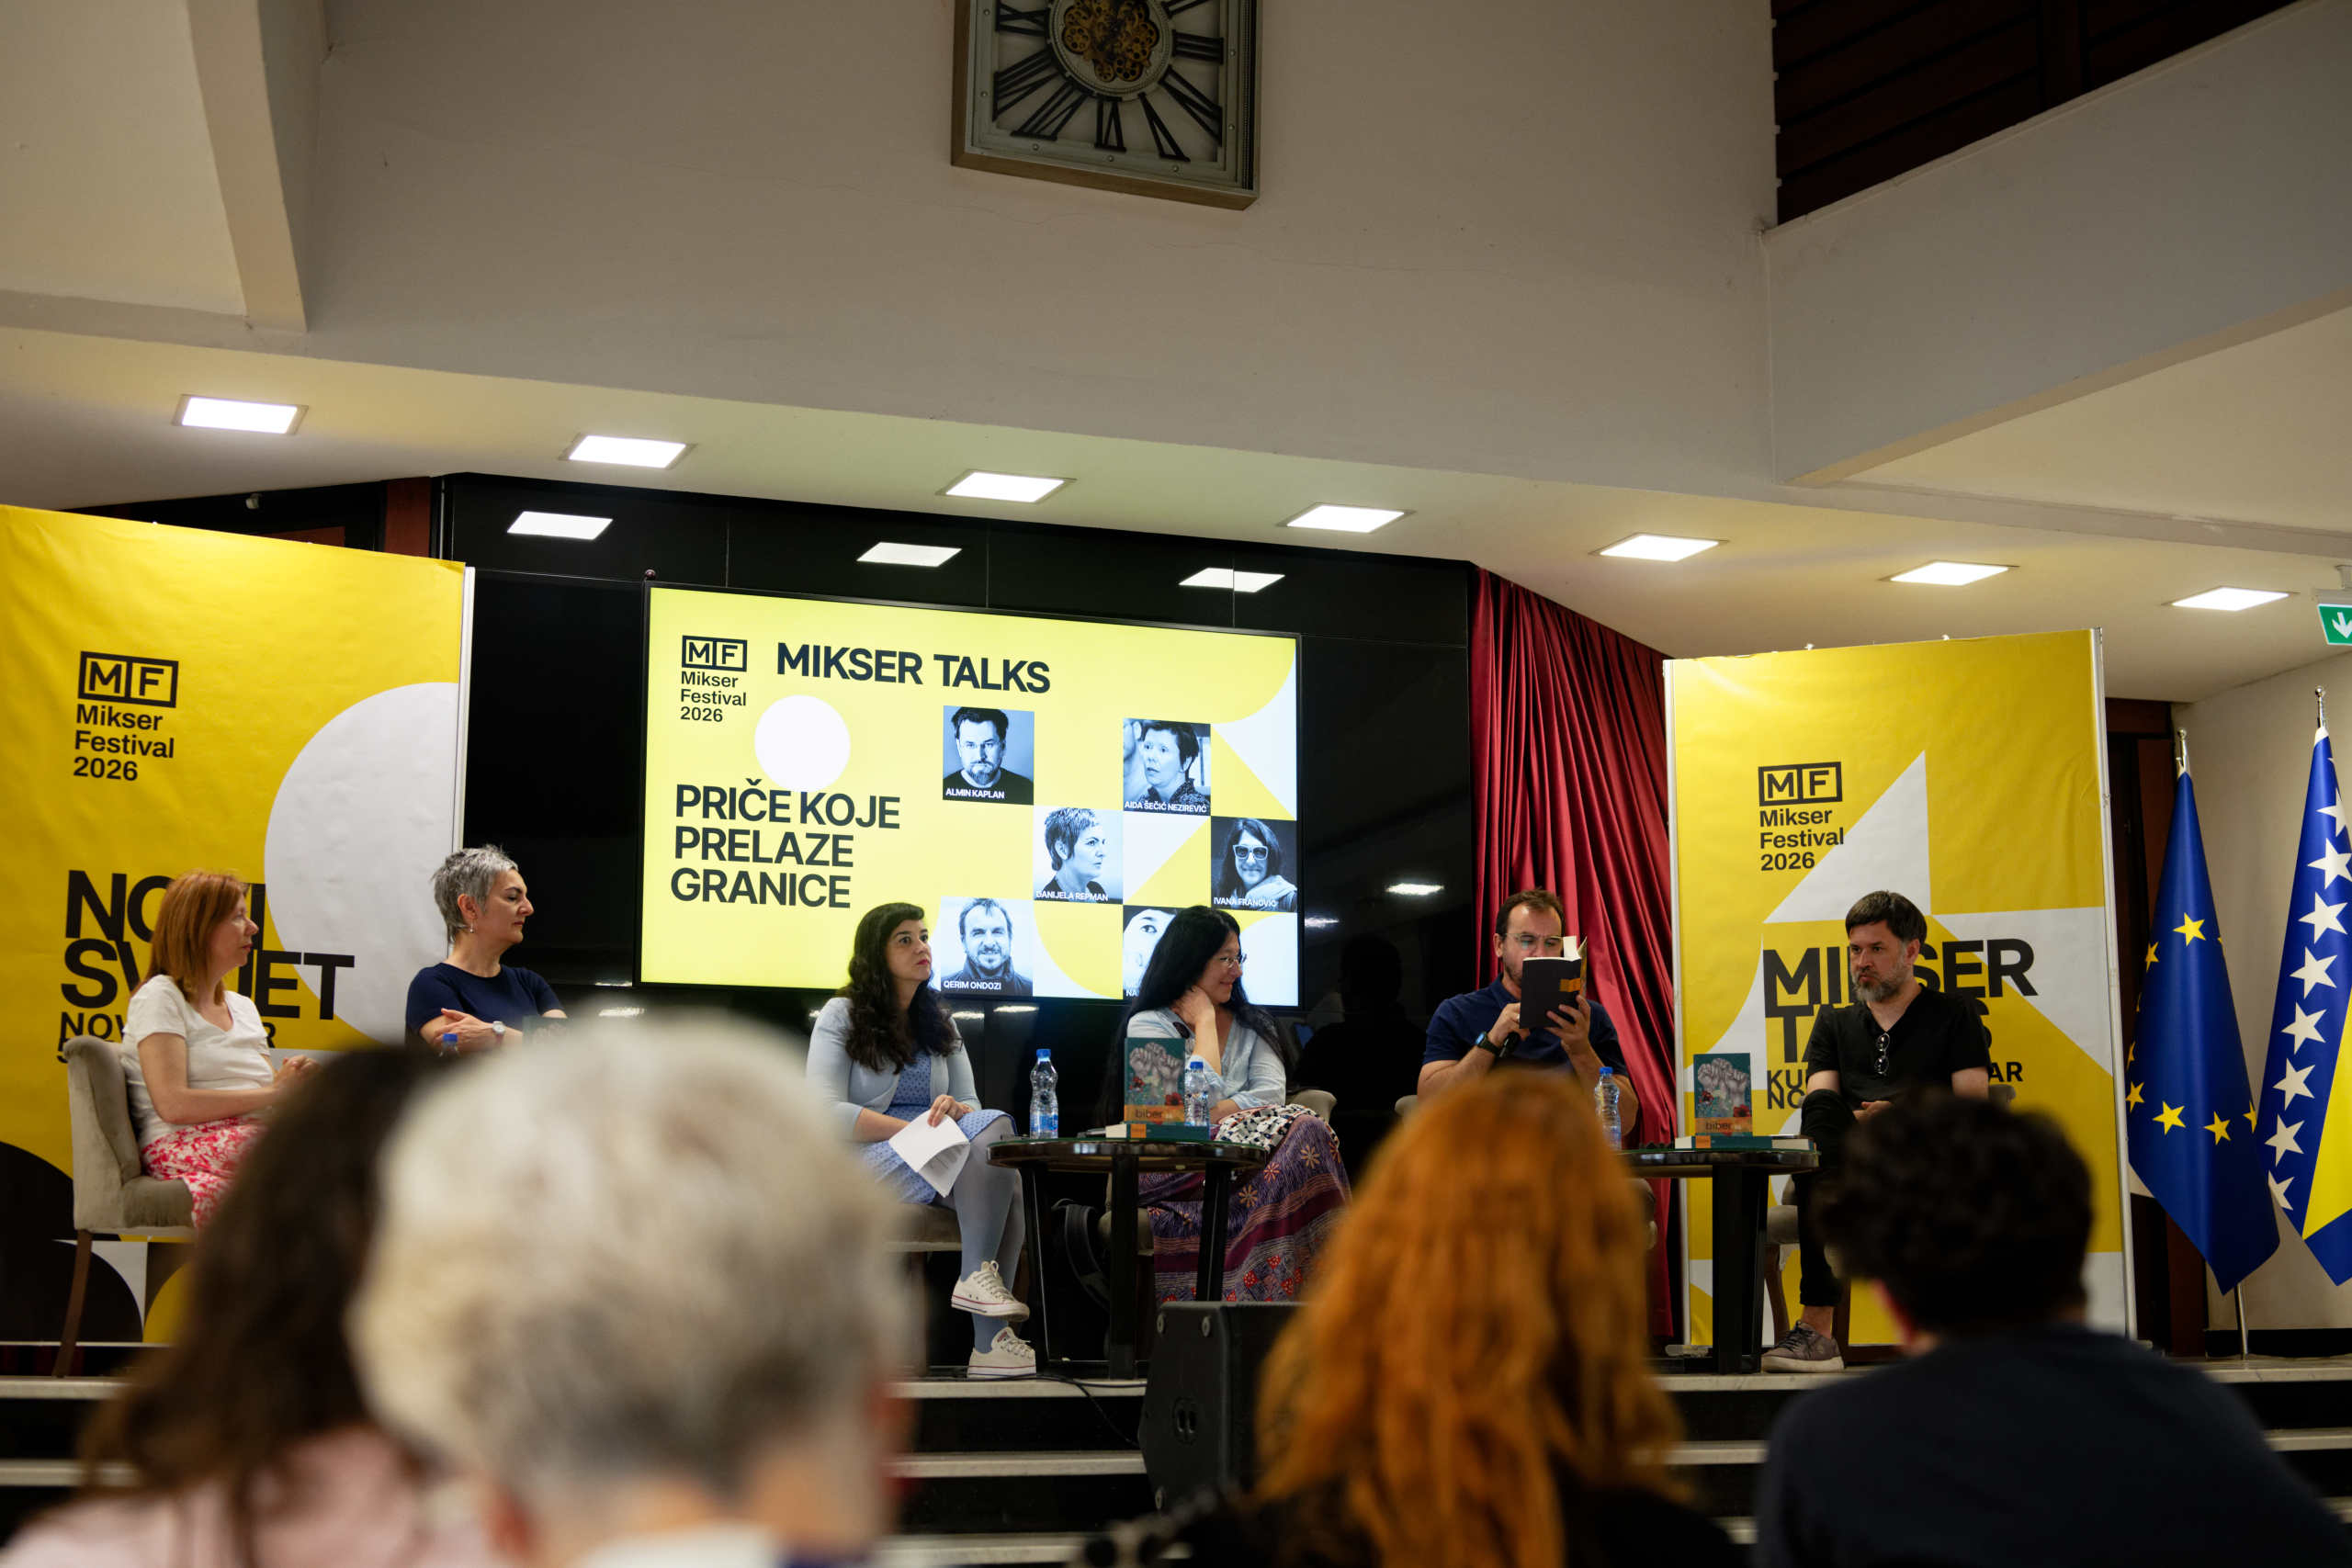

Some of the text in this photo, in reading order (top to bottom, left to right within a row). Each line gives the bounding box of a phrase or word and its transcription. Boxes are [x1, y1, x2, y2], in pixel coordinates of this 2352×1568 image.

[777, 642, 923, 685] MIKSER
[933, 653, 1051, 694] TALKS
[681, 671, 739, 688] Mikser
[680, 688, 747, 706] Festival
[76, 704, 164, 731] Mikser
[680, 706, 723, 722] 2026
[74, 730, 175, 759] Festival
[73, 757, 139, 782] 2026
[675, 778, 900, 829] PRIČE KOJE
[945, 788, 1005, 799] ALMIN KAPLAN
[1124, 801, 1143, 809] AIDA
[1758, 807, 1832, 828] Mikser
[674, 826, 854, 867] PRELAZE
[1759, 828, 1844, 850] Festival
[1760, 852, 1815, 872] 2026
[671, 867, 851, 908] GRANICE
[1214, 897, 1236, 905] IVANA
[1762, 938, 2039, 1006] MISER
[943, 980, 1001, 990] QERIM ONDOZI
